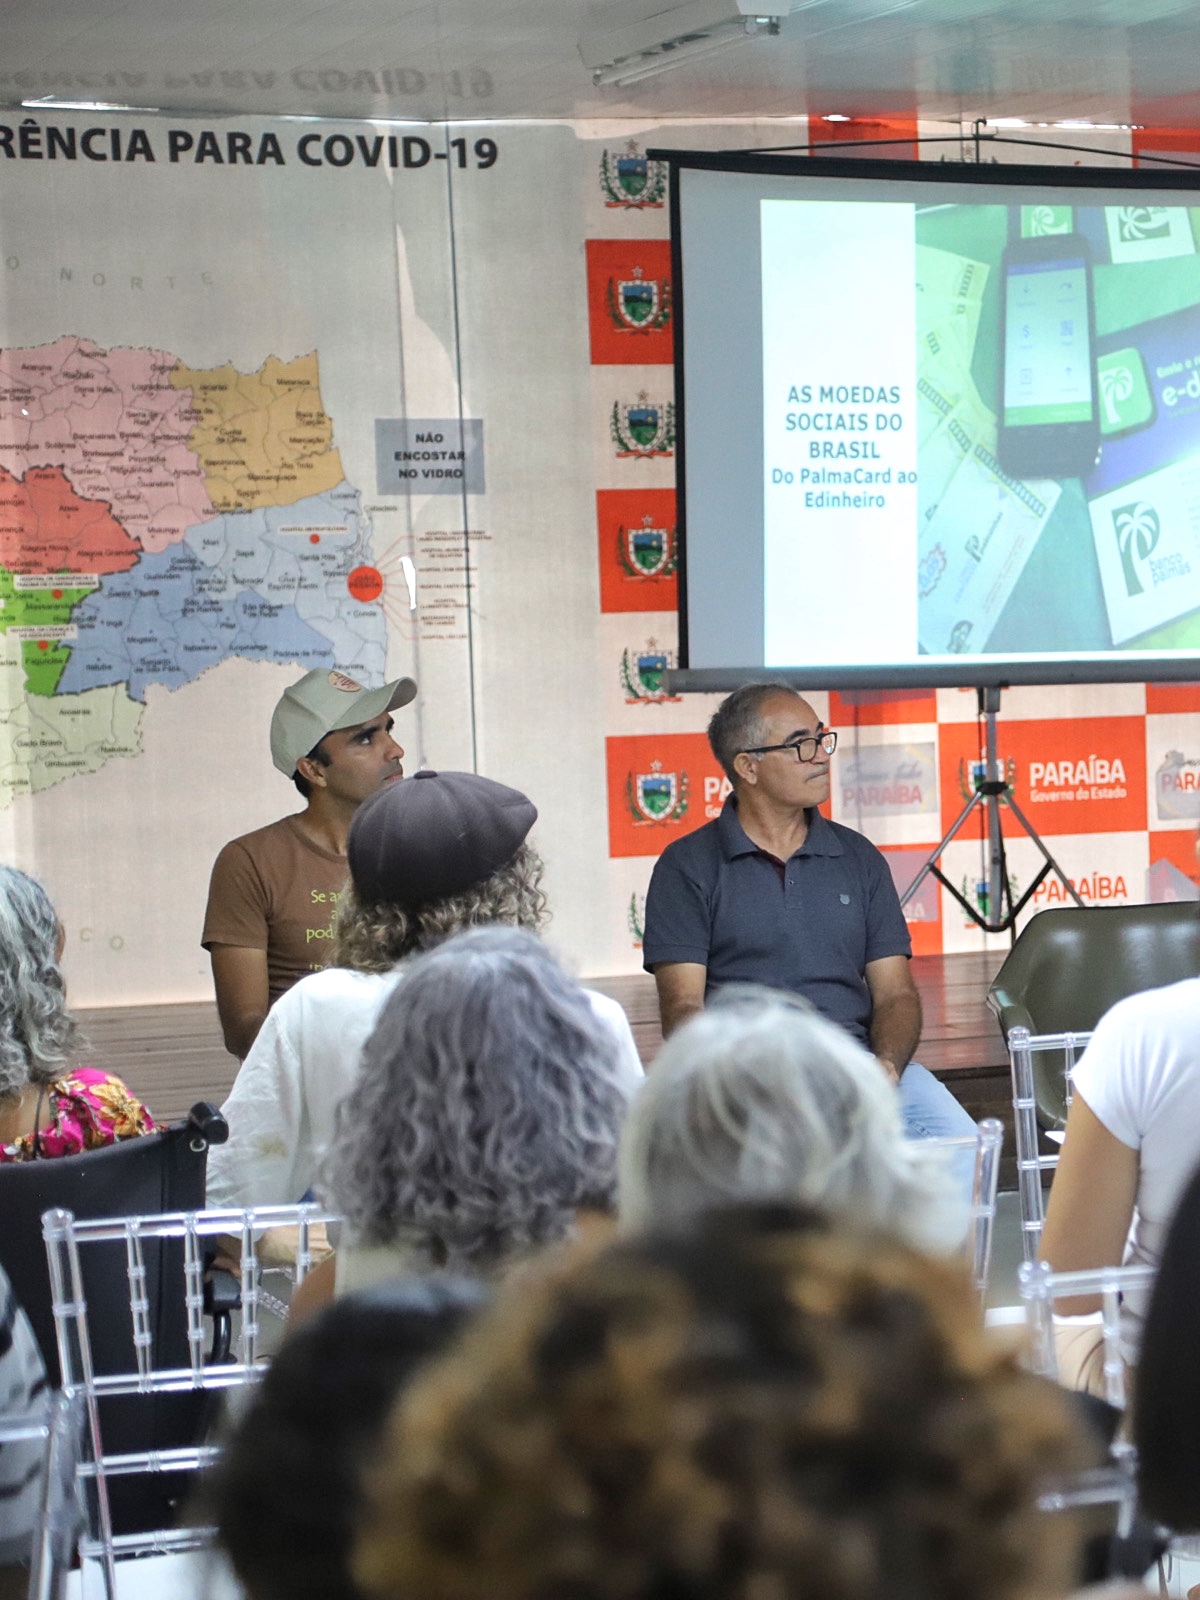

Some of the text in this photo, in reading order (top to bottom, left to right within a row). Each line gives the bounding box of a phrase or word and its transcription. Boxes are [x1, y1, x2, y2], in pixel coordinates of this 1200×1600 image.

[0, 118, 498, 169] RÊNCIA PARA COVID-19
[788, 385, 901, 404] AS MOEDAS
[786, 413, 902, 431] SOCIAIS DO
[394, 451, 465, 462] ENCOSTAR
[809, 441, 881, 459] BRASIL
[399, 469, 463, 479] NO VIDRO
[772, 467, 917, 484] Do PalmaCard ao
[805, 491, 885, 508] Edinheiro
[1030, 754, 1126, 786] PARAÍBA
[1030, 786, 1127, 803] Governo do Estado
[311, 889, 326, 904] Se
